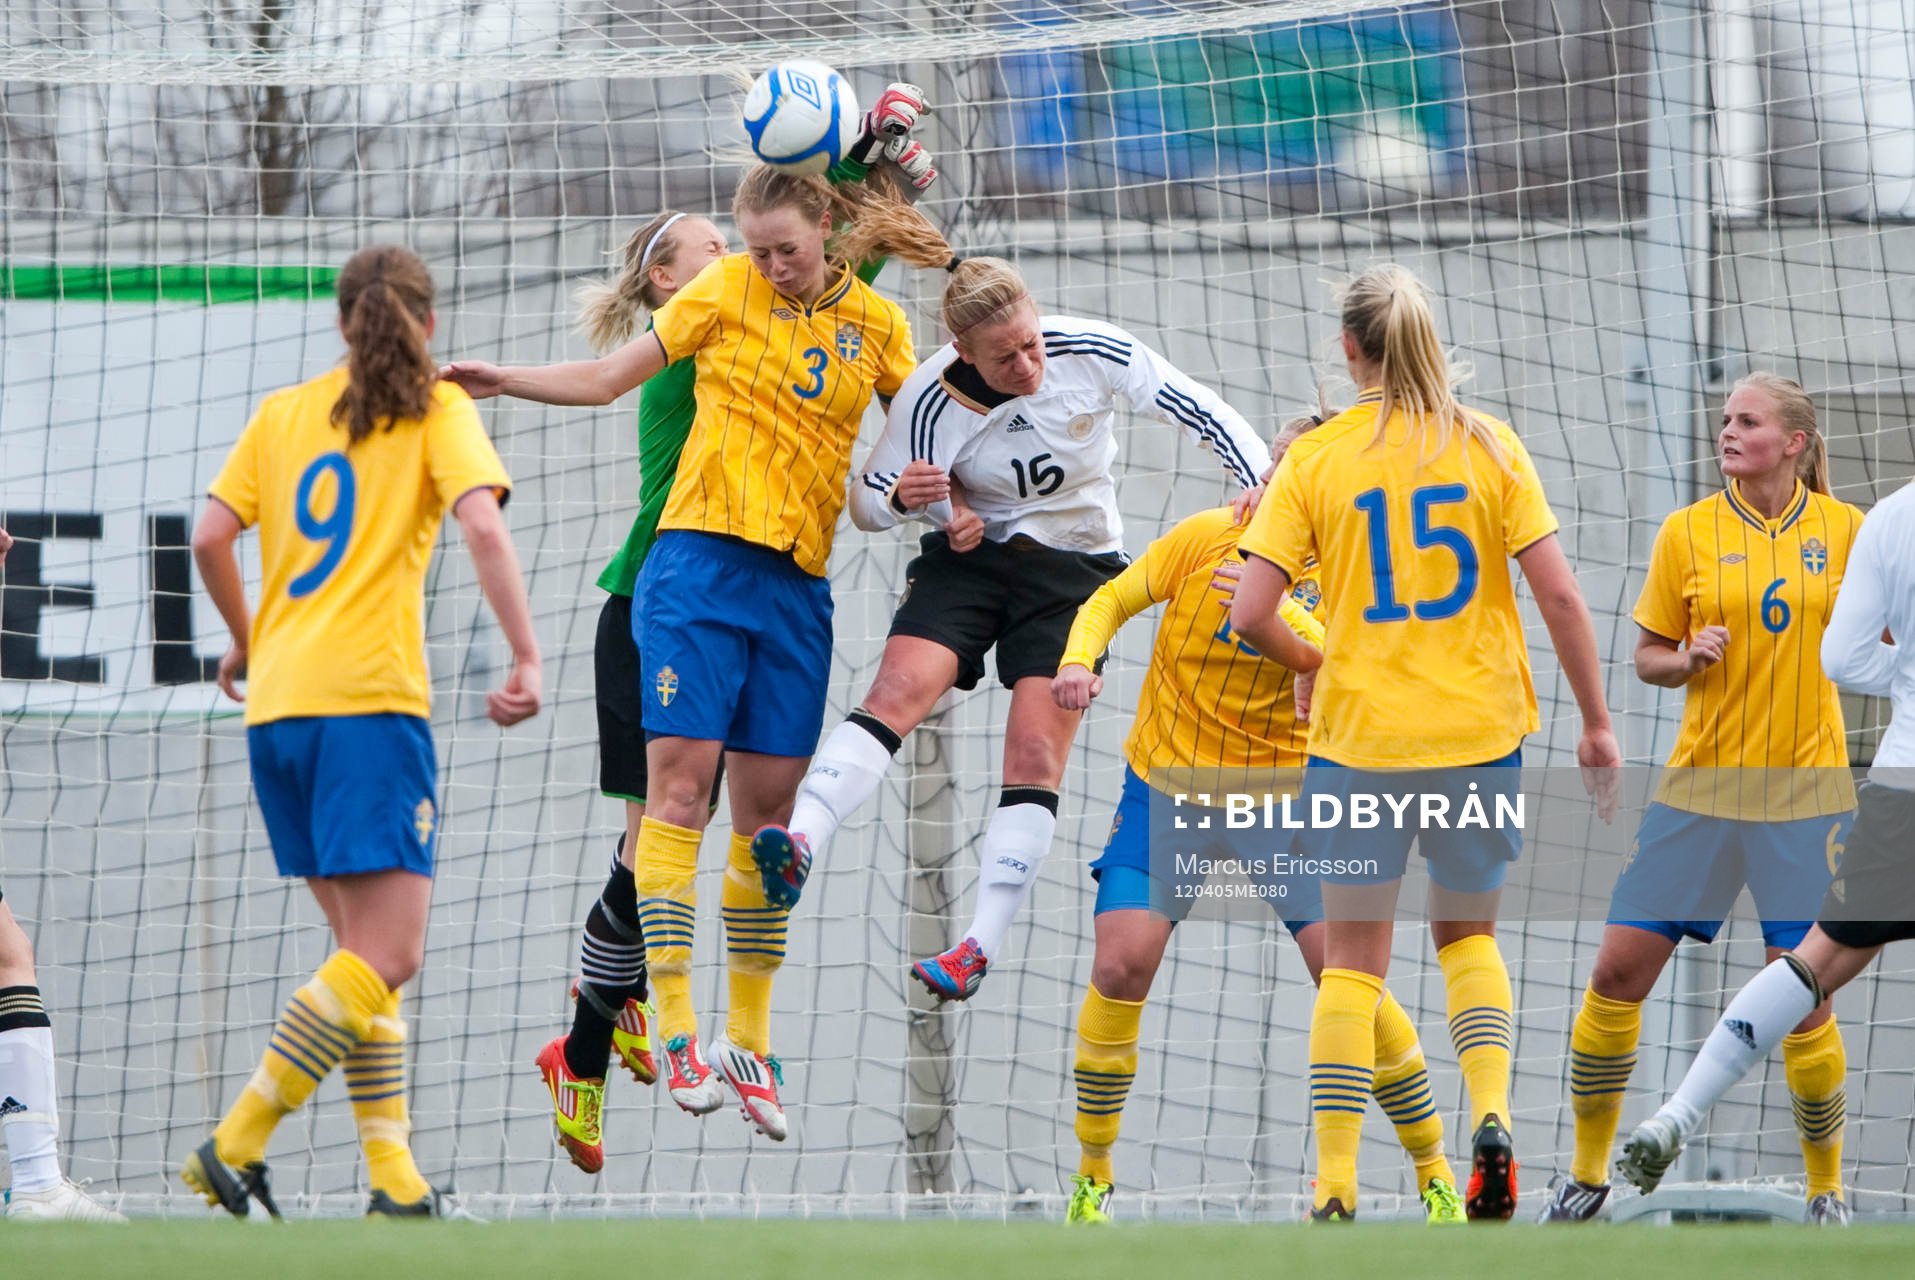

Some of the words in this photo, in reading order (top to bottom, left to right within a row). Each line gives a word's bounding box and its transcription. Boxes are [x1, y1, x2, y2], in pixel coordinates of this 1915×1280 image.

[792, 346, 828, 399] 3
[1006, 424, 1034, 433] adidas
[1010, 453, 1065, 498] 15
[288, 451, 356, 598] 9
[1354, 483, 1479, 623] 15
[1761, 577, 1791, 634] 6
